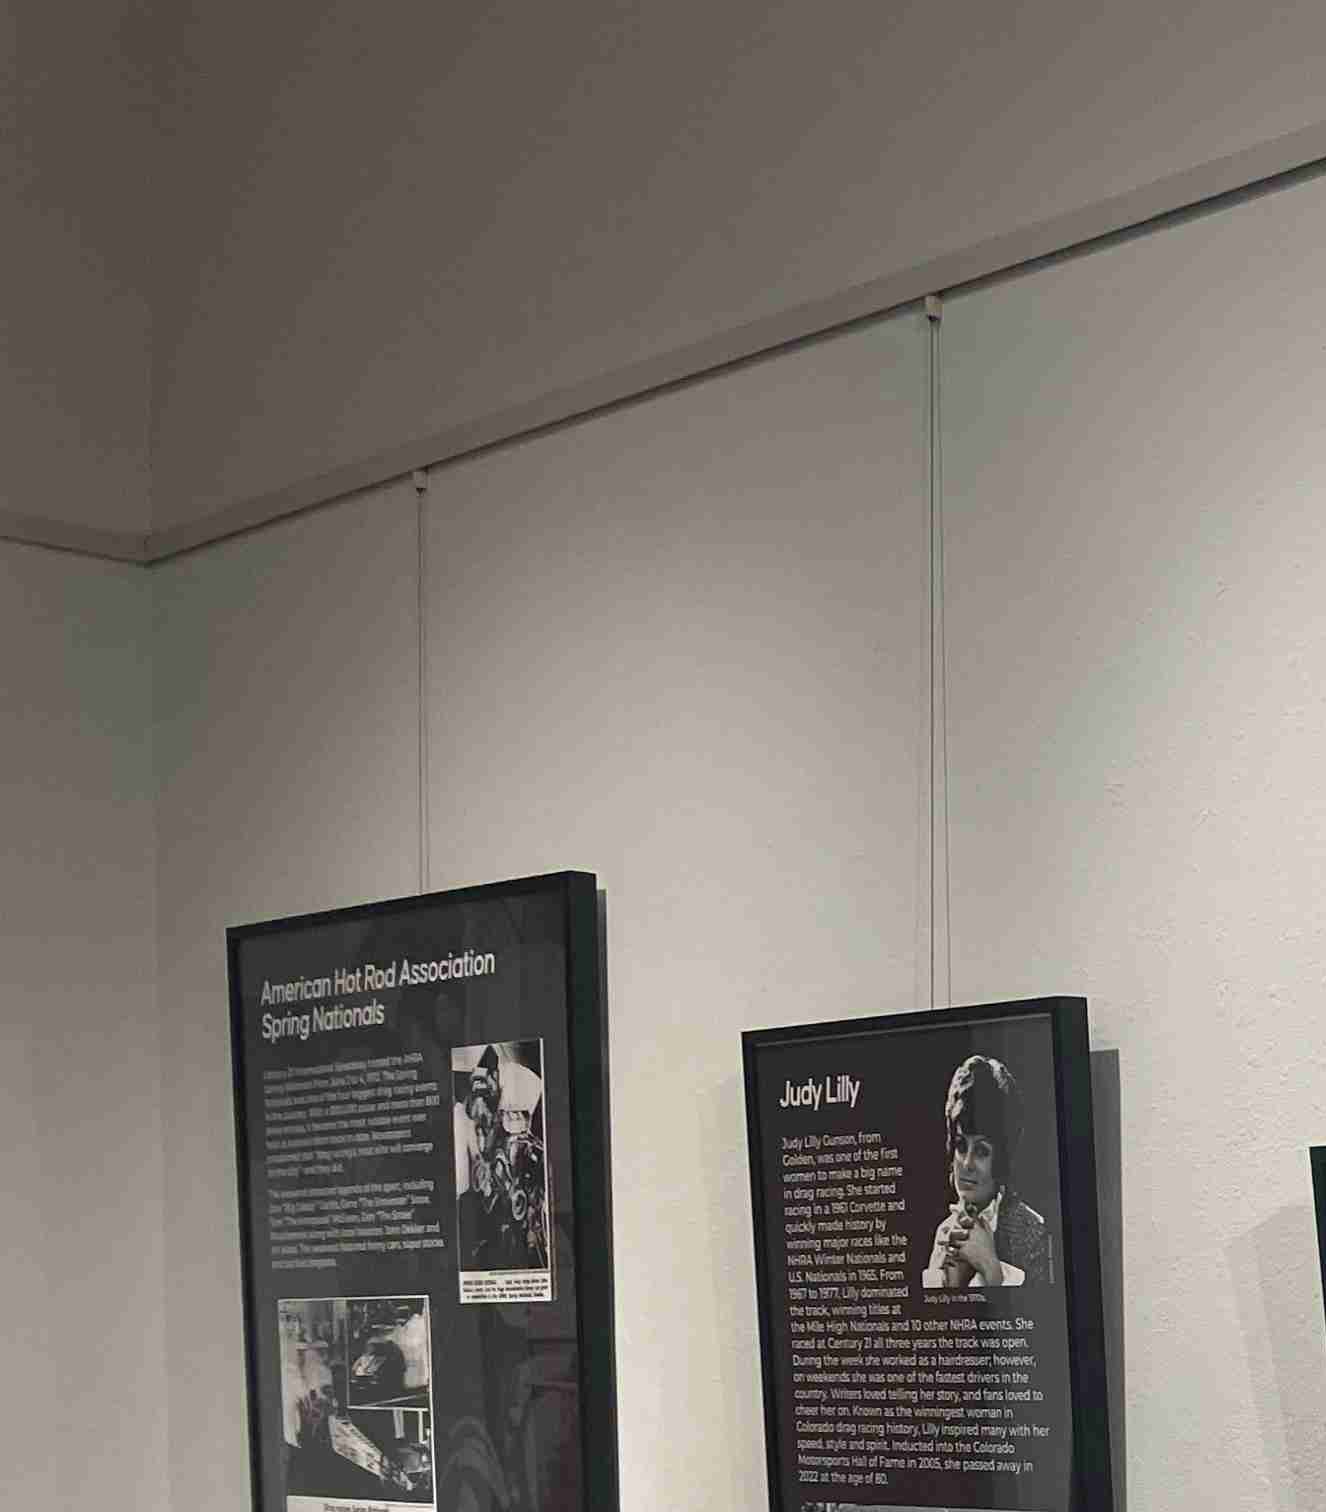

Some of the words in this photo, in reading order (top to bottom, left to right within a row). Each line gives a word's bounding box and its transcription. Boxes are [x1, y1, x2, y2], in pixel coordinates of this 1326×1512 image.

[262, 976, 330, 1003] American
[334, 967, 361, 994] Hot
[364, 961, 396, 990] Rod
[398, 949, 495, 985] Association
[262, 1011, 310, 1040] Spring
[313, 998, 385, 1032] Nationals
[779, 1078, 822, 1110] Judy
[826, 1075, 860, 1107] Lilly
